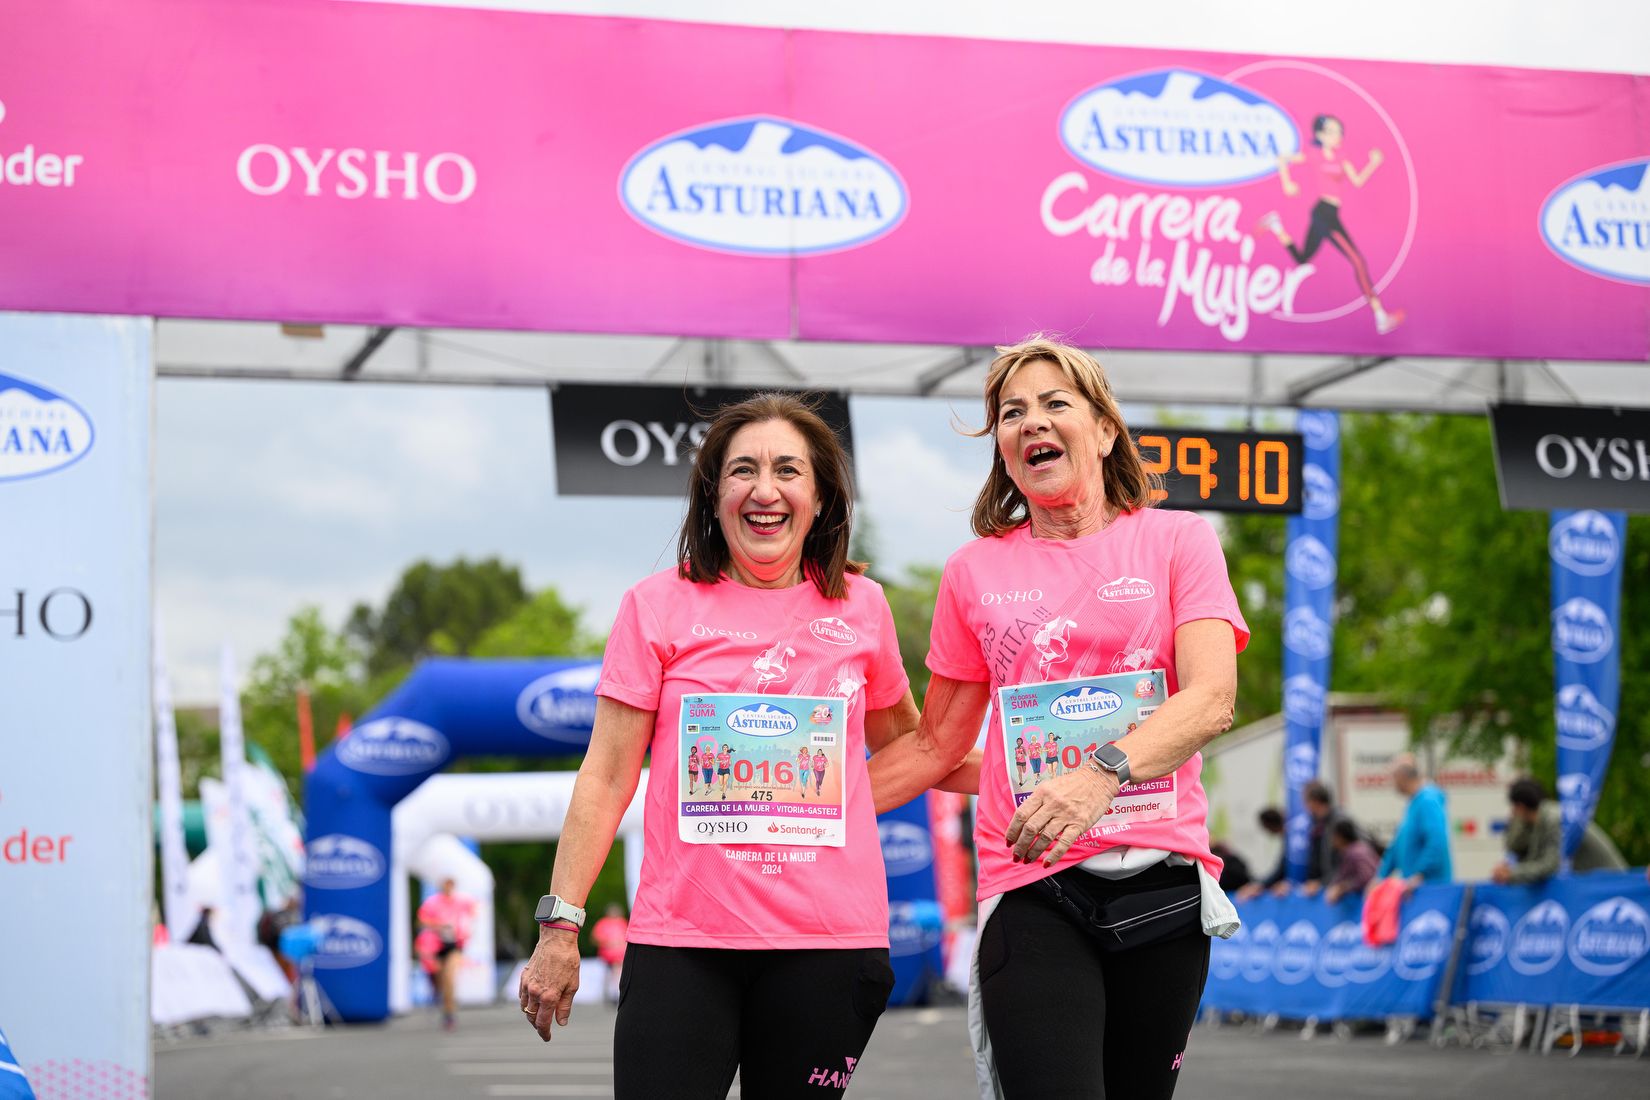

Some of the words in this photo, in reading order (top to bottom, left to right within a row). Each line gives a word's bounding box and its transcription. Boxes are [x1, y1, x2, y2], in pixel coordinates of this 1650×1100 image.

[1082, 110, 1281, 158] ASTURIANA
[0, 143, 84, 188] der
[236, 143, 477, 204] OYSHO
[647, 164, 884, 219] ASTURIANA
[1040, 172, 1241, 243] Carrera
[1090, 237, 1132, 286] de
[1136, 241, 1166, 287] la
[1157, 235, 1315, 341] Mujer
[981, 588, 1043, 606] OYSHO
[1102, 586, 1151, 599] ASTURIANA
[813, 622, 854, 642] ASTURIANA
[1018, 693, 1038, 701] DORSAL
[1011, 699, 1039, 710] SUMA
[1055, 699, 1118, 715] ASTURIANA
[689, 708, 717, 718] SUMA
[732, 714, 793, 730] ASTURIANA
[733, 759, 794, 785] 016
[1120, 780, 1170, 793] ORIA-GASTEIZ
[751, 790, 773, 801] 475
[685, 804, 719, 813] CARRERA
[721, 804, 731, 812] DE
[733, 804, 743, 812] LA
[744, 803, 770, 812] MUJER
[776, 805, 838, 816] VITORIA-GASTEIZ
[1114, 801, 1160, 814] Santander
[697, 822, 748, 834] OYSHO
[780, 824, 827, 835] Santander
[1090, 828, 1101, 839] LA
[3, 826, 74, 864] der
[725, 849, 763, 862] CARRERA
[764, 851, 776, 862] DE
[777, 852, 788, 862] LA
[789, 851, 816, 862] MUJER
[761, 864, 782, 875] 2024
